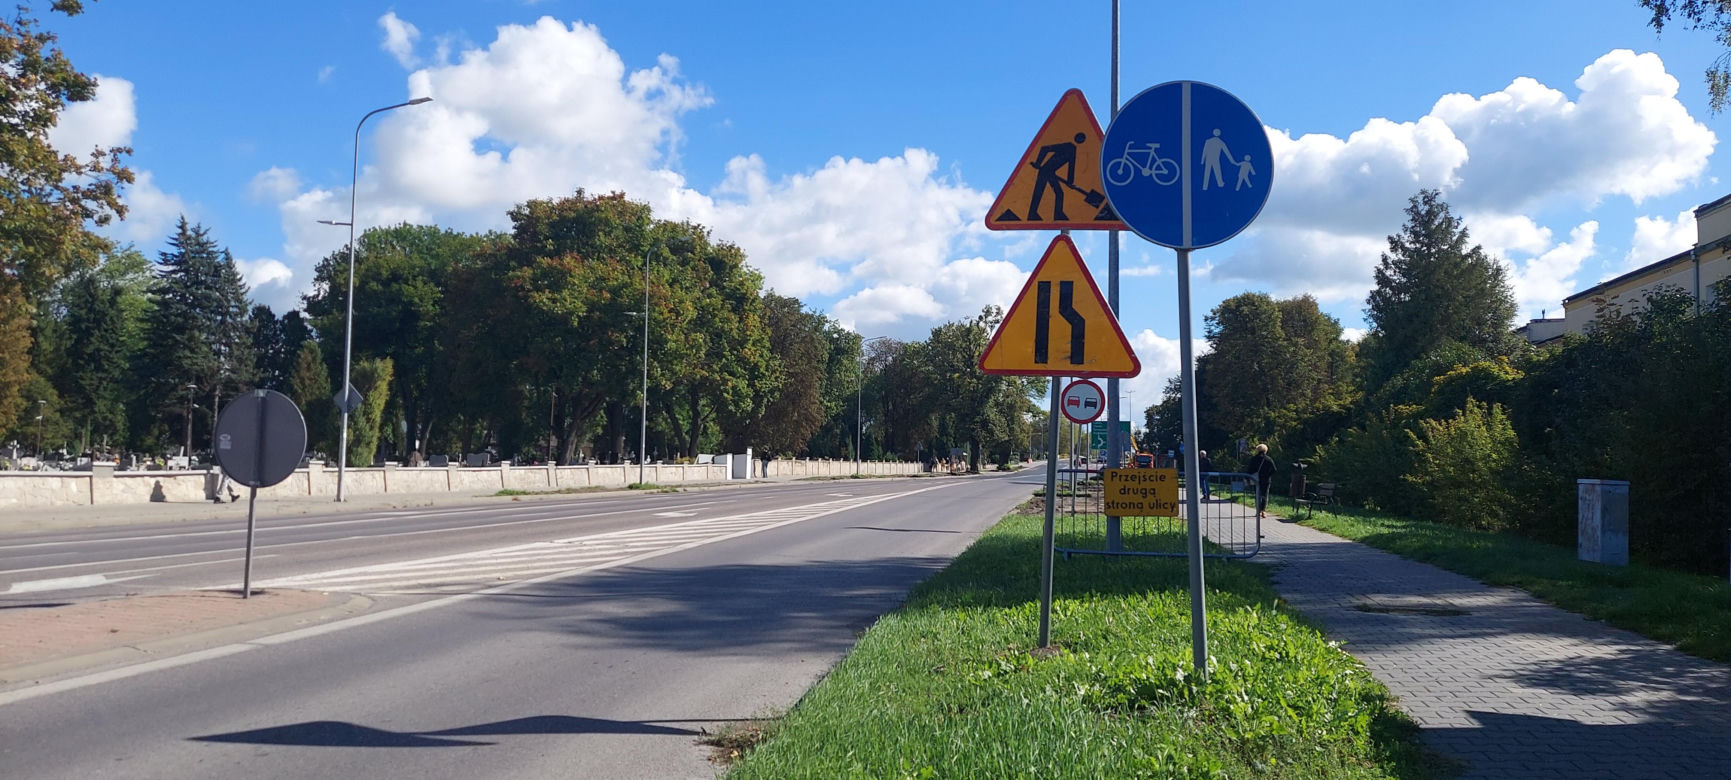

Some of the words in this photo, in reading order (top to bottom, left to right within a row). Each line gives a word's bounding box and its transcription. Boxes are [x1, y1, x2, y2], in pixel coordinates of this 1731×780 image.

[1111, 471, 1166, 485] Przejście
[1119, 485, 1156, 498] drugą
[1107, 500, 1144, 512] stroną
[1148, 499, 1176, 513] ulicy
